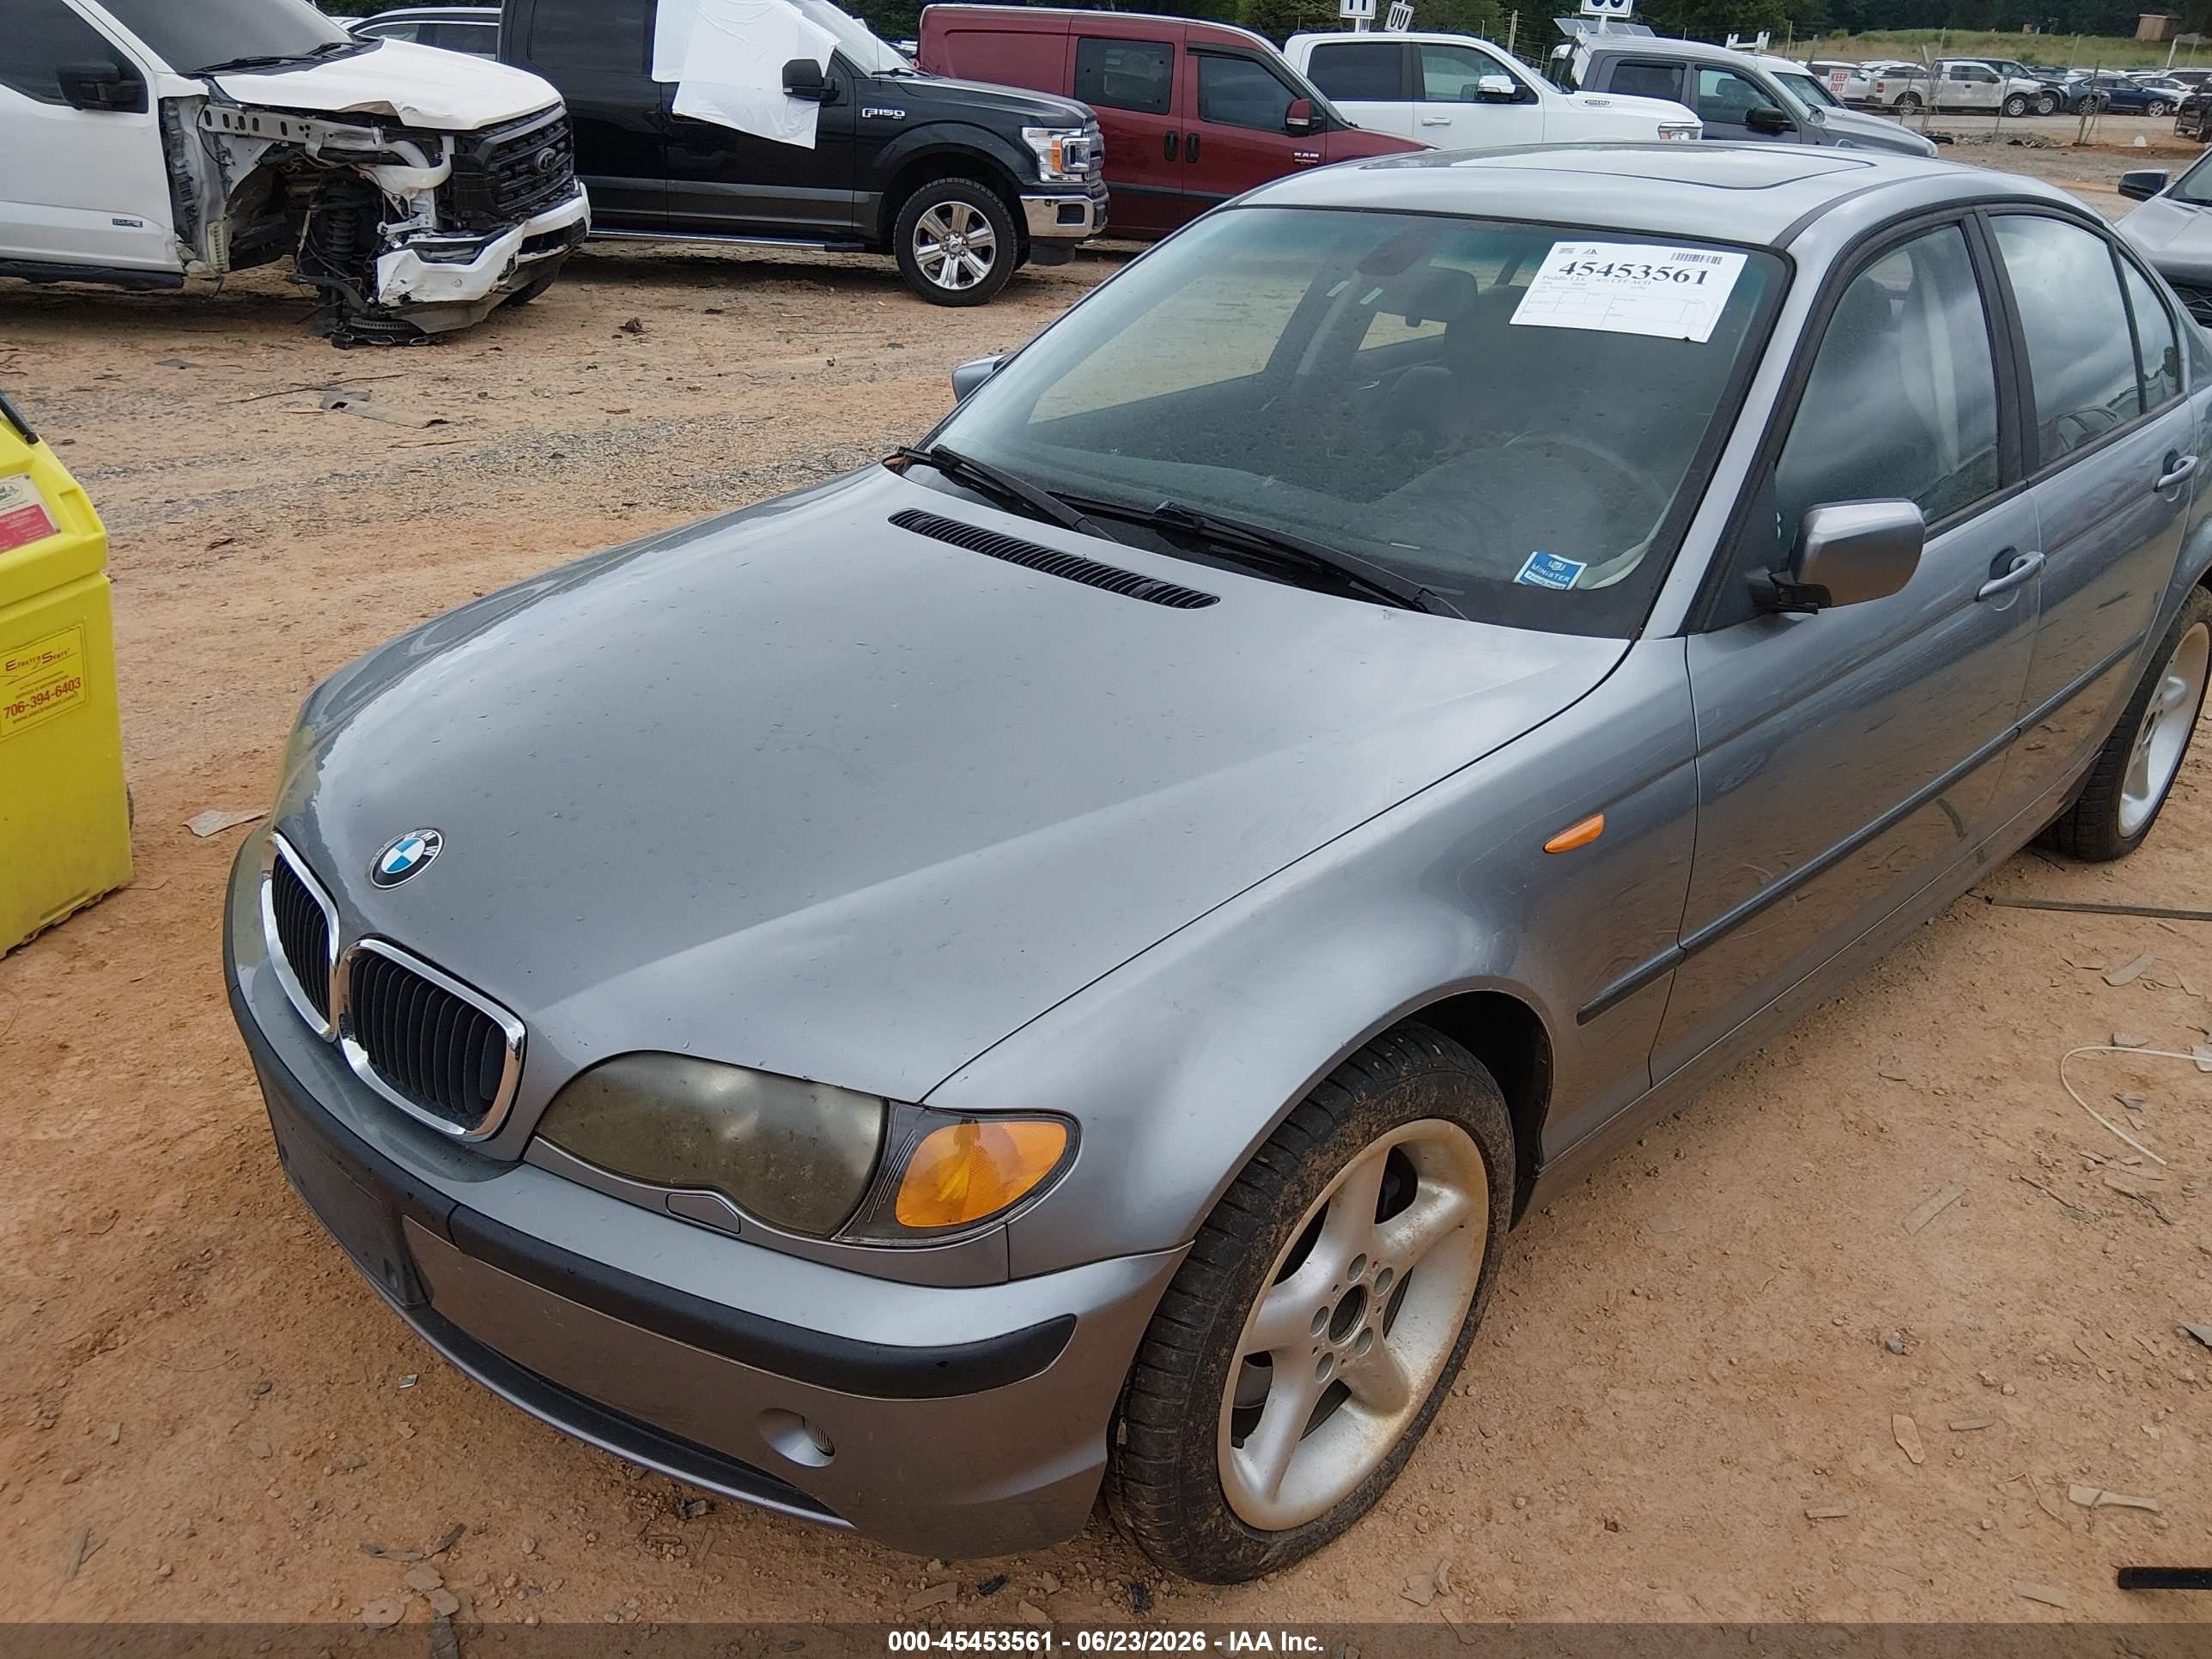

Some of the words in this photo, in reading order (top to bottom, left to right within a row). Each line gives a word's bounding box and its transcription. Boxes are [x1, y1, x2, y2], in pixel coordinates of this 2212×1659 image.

[1831, 72, 1848, 82] KEEP
[1831, 82, 1844, 92] OUT
[1558, 260, 1711, 286] 45453561
[1530, 562, 1572, 583] MINISTER
[3, 677, 82, 719] 706-394-6403
